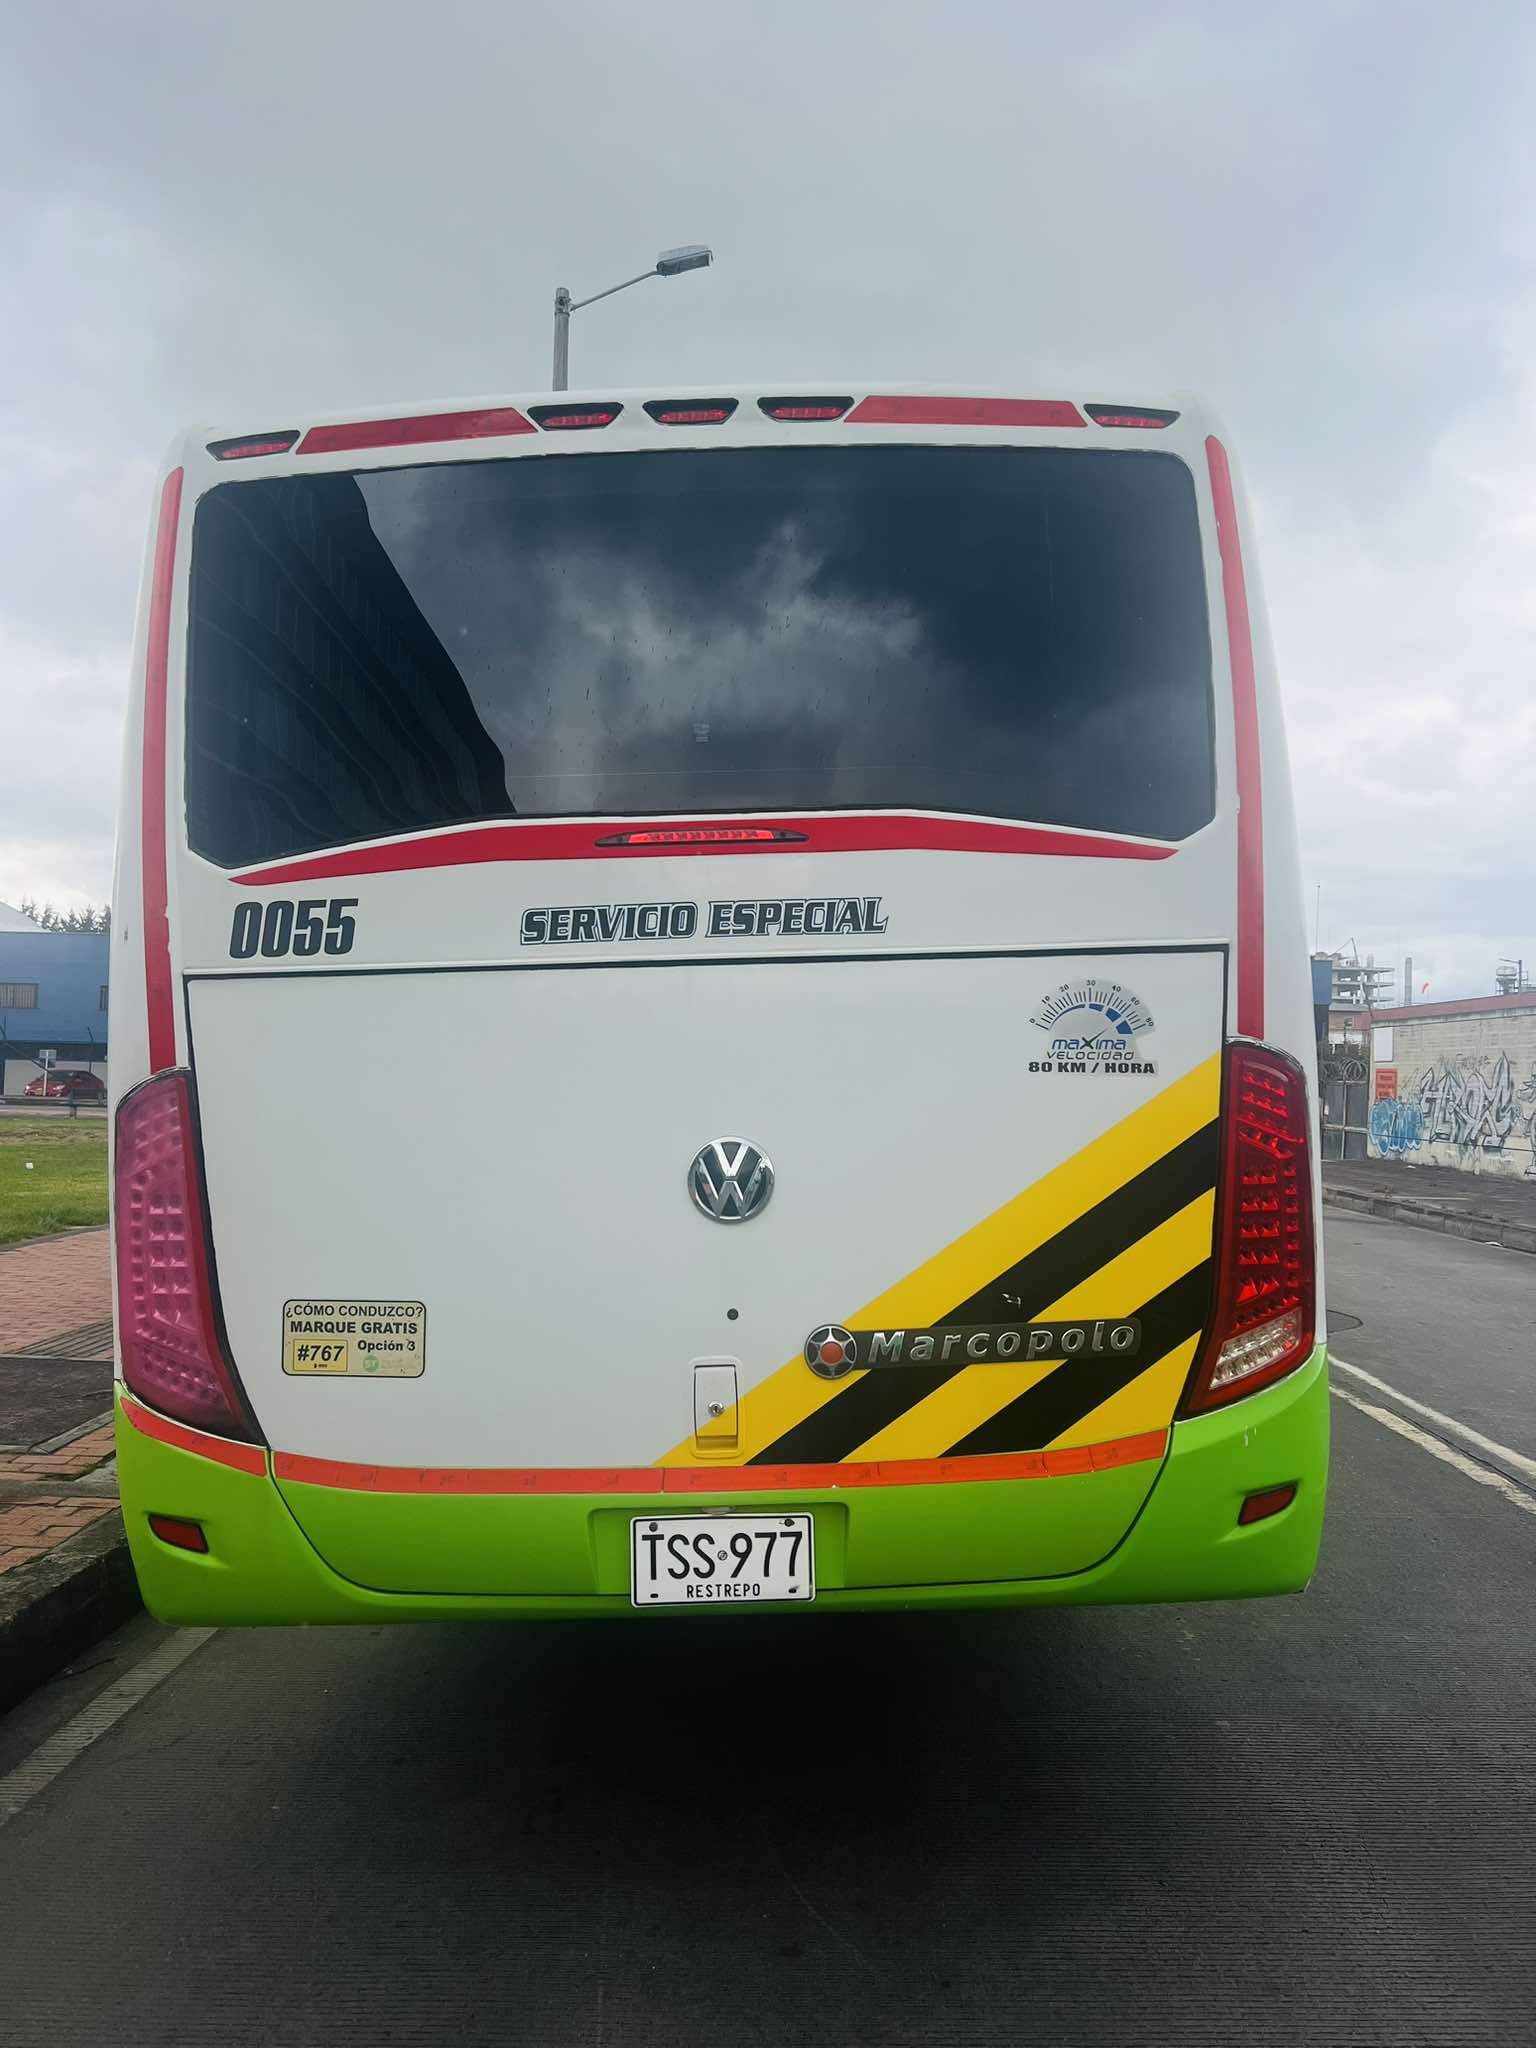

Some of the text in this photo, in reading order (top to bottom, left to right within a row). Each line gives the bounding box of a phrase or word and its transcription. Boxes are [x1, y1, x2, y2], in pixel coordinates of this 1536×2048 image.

[229, 898, 359, 959] 0055
[520, 897, 889, 945] SERVICIO ESPECIAL
[1042, 995, 1050, 1004] 10
[1059, 984, 1069, 992] 20
[1028, 1062, 1155, 1074] 80 KM / HORA
[286, 1303, 424, 1318] ¿CÓMO CONDUZCO?
[290, 1321, 417, 1334] MARQUE GRATIS
[358, 1340, 403, 1353] Opción
[867, 1321, 1135, 1363] Marcopolo
[297, 1344, 344, 1361] #767
[642, 1531, 803, 1580] TSS 977
[686, 1583, 760, 1598] RESTREPO
